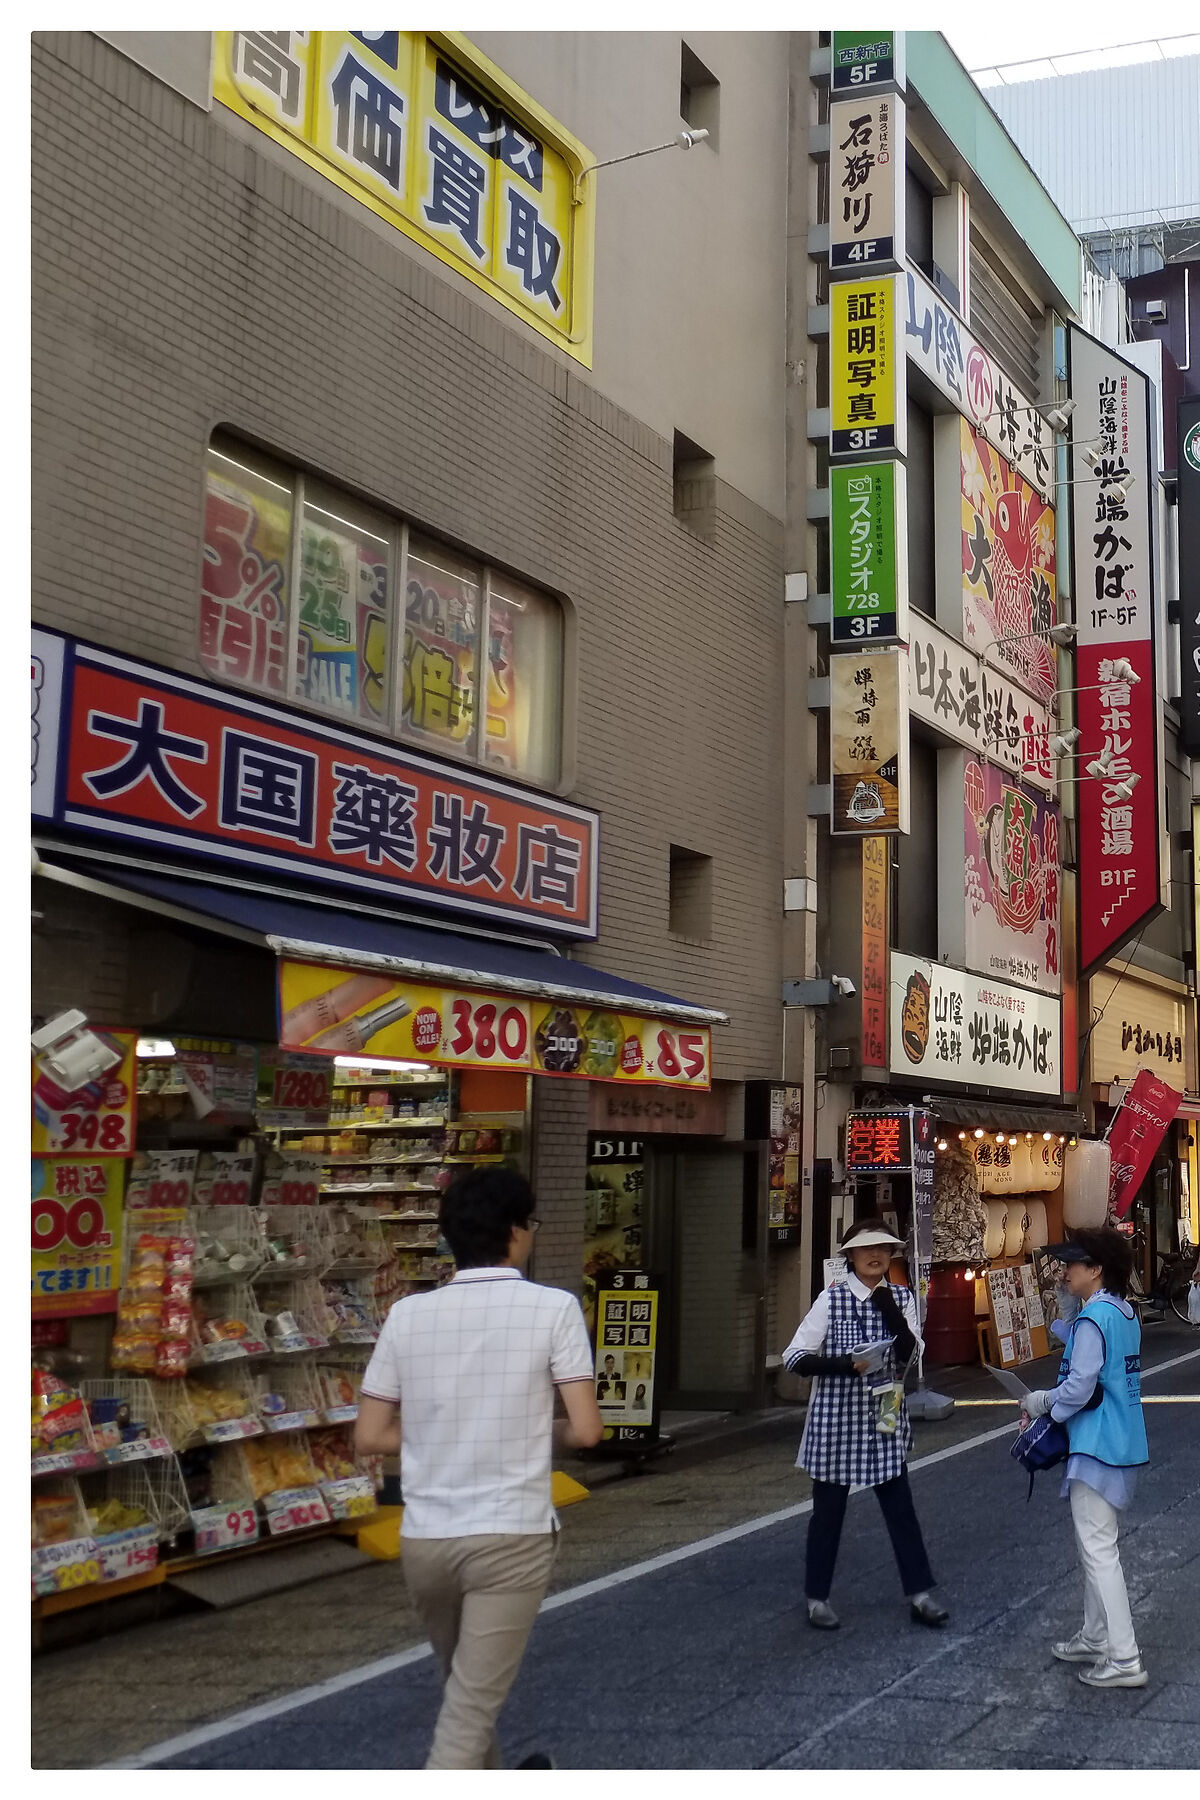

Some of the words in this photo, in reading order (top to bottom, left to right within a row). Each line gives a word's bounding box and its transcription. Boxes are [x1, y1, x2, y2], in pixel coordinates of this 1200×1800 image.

[838, 43, 890, 63] 西新宿
[850, 64, 877, 83] 5F
[839, 114, 875, 235] 石狩川
[848, 243, 876, 261] 4F
[847, 294, 877, 423] 証明写真
[849, 430, 878, 448] 3F
[849, 497, 874, 589] スタジオ
[846, 593, 880, 610] 728
[851, 617, 880, 635] 3F
[880, 766, 898, 778] B1F
[83, 698, 582, 914] 大国藥妝店
[1101, 868, 1137, 887] B1F
[935, 986, 963, 1026] 山陰
[416, 1012, 437, 1024] NOW
[419, 1024, 435, 1036] ON
[968, 1011, 1053, 1075] 炉端かば
[851, 1118, 901, 1164] 営業
[56, 1164, 107, 1196] 税込
[606, 1300, 652, 1322] 証明
[604, 1325, 651, 1347] 写真
[226, 1510, 258, 1538] 93
